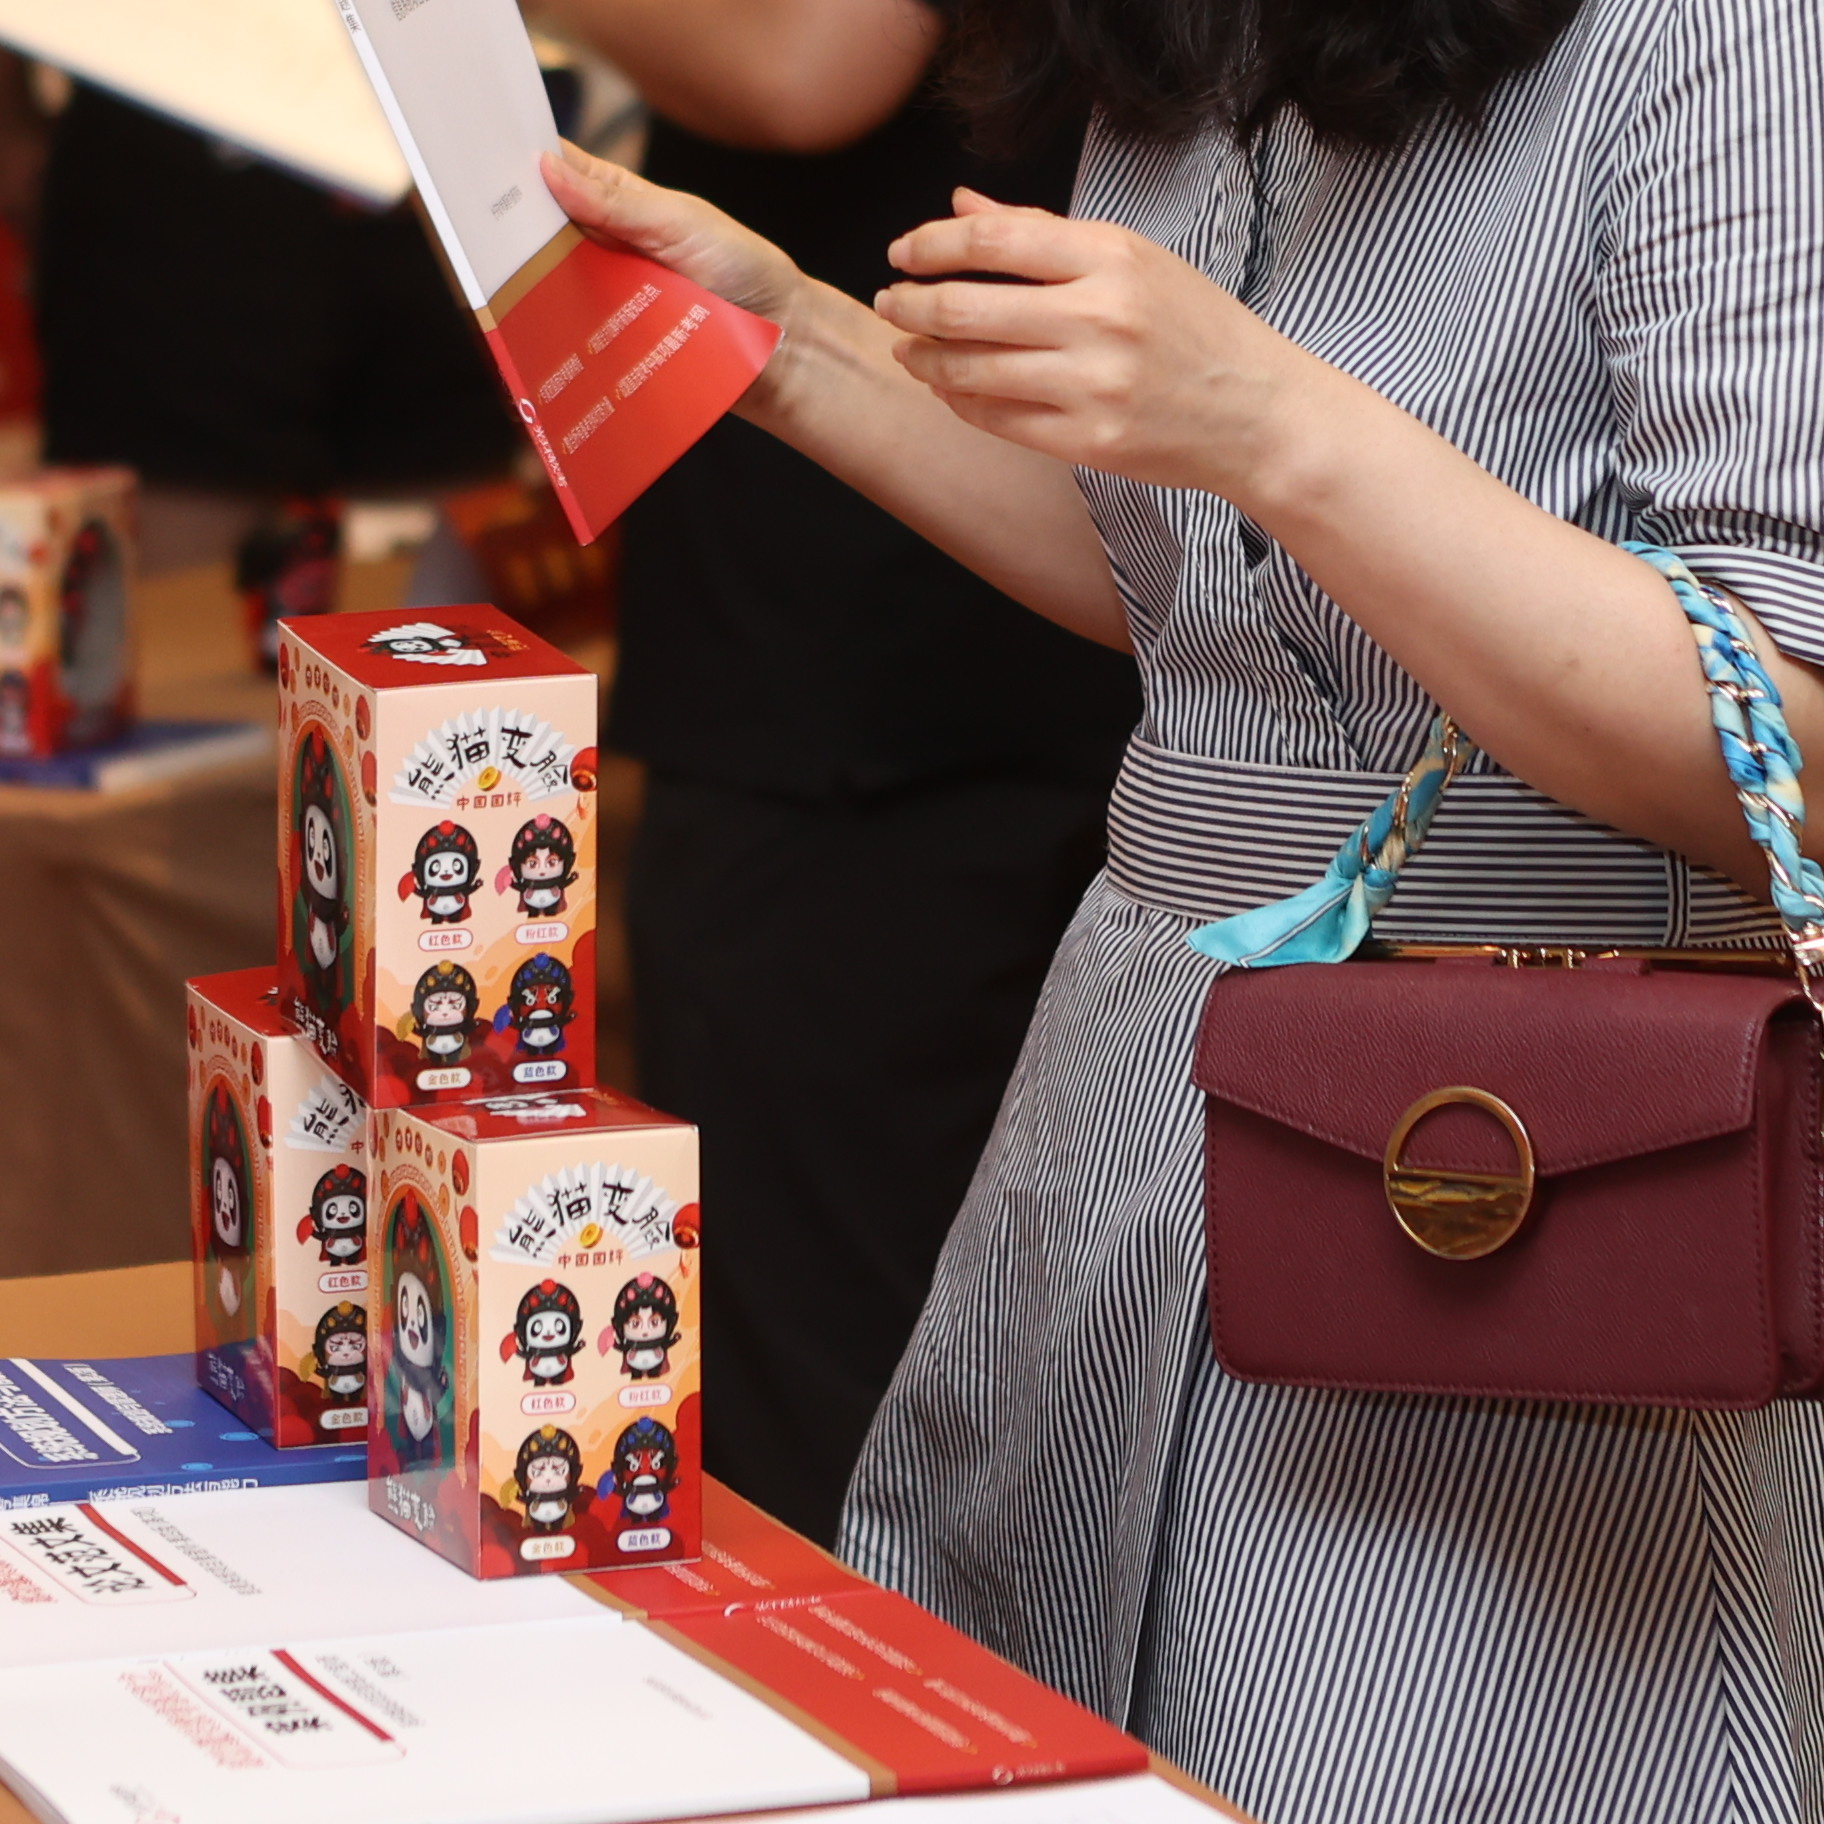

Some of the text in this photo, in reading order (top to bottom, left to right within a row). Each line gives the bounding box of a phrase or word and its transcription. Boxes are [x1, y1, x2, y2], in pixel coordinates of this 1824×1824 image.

[407, 726, 570, 801] 熊猫变脸
[427, 933, 464, 947] 红色款
[427, 1070, 463, 1086] 金色款
[523, 1064, 558, 1079] 蓝色款
[507, 1180, 671, 1257] 熊猫变脸
[327, 1275, 363, 1289] 红色款
[530, 1395, 567, 1411] 红色款
[330, 1411, 365, 1426] 金色款
[530, 1539, 566, 1556] 金色款
[10, 1516, 153, 1596] 论文范文集
